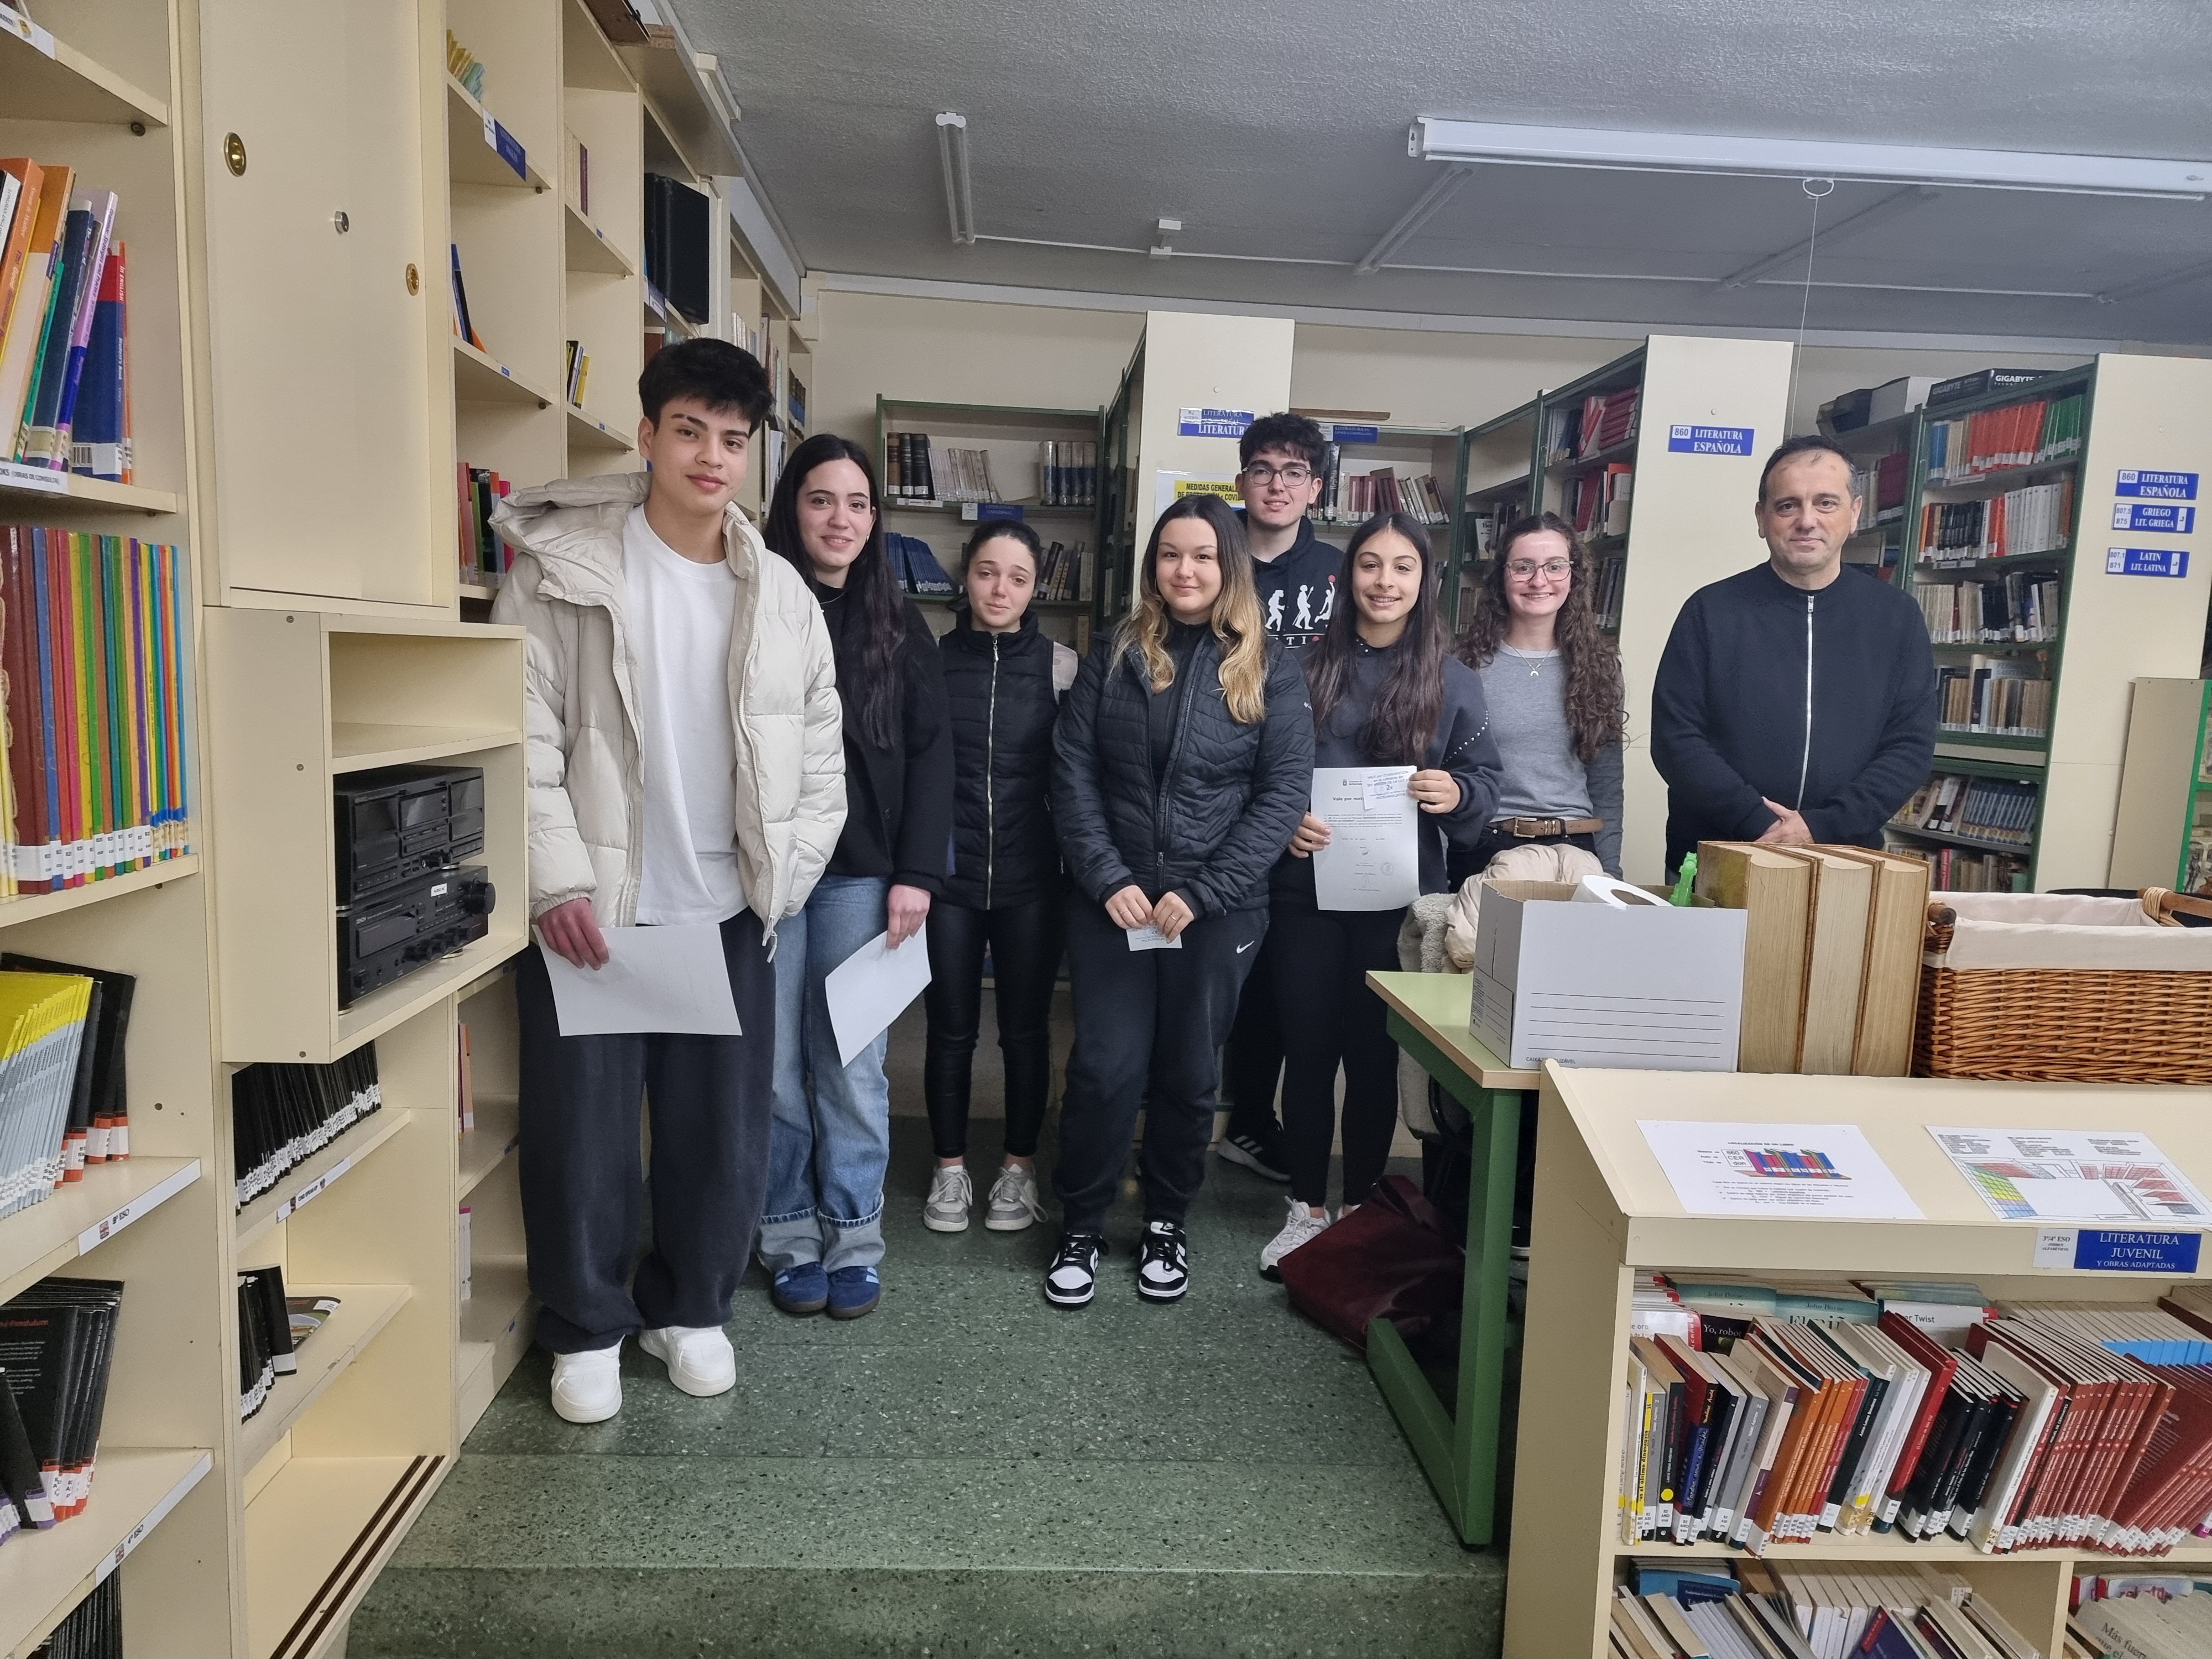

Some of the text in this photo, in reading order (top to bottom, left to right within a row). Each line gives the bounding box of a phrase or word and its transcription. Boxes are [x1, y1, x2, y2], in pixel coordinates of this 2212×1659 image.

[97, 236, 109, 263] Strategies
[8, 265, 19, 288] Good
[92, 275, 100, 297] Practice
[1198, 424, 1245, 435] LITERATUR
[1695, 429, 1743, 440] LITERATURA
[1693, 441, 1741, 453] ESPAÑOLA
[2142, 474, 2188, 484] LITERATURA
[2140, 485, 2186, 498] ESPAÑOLA
[2142, 507, 2171, 517] GRIEGO
[2149, 519, 2174, 528] GRIEGA
[2140, 552, 2162, 561] LATIN
[2143, 564, 2166, 572] LATINA
[356, 916, 367, 925] DENON
[119, 1208, 129, 1220] ESO
[2099, 1233, 2179, 1245] LITERATURA
[2110, 1248, 2163, 1259] JUVENIL
[1914, 1314, 1935, 1323] Twist
[1704, 1324, 1742, 1337] Yo, robot
[2048, 1429, 2058, 1443] MIGUEL
[2056, 1404, 2070, 1425] CERVANTES
[1686, 1479, 1696, 1505] Sandra
[134, 1524, 144, 1539] ESO
[2101, 1623, 2122, 1644] Más
